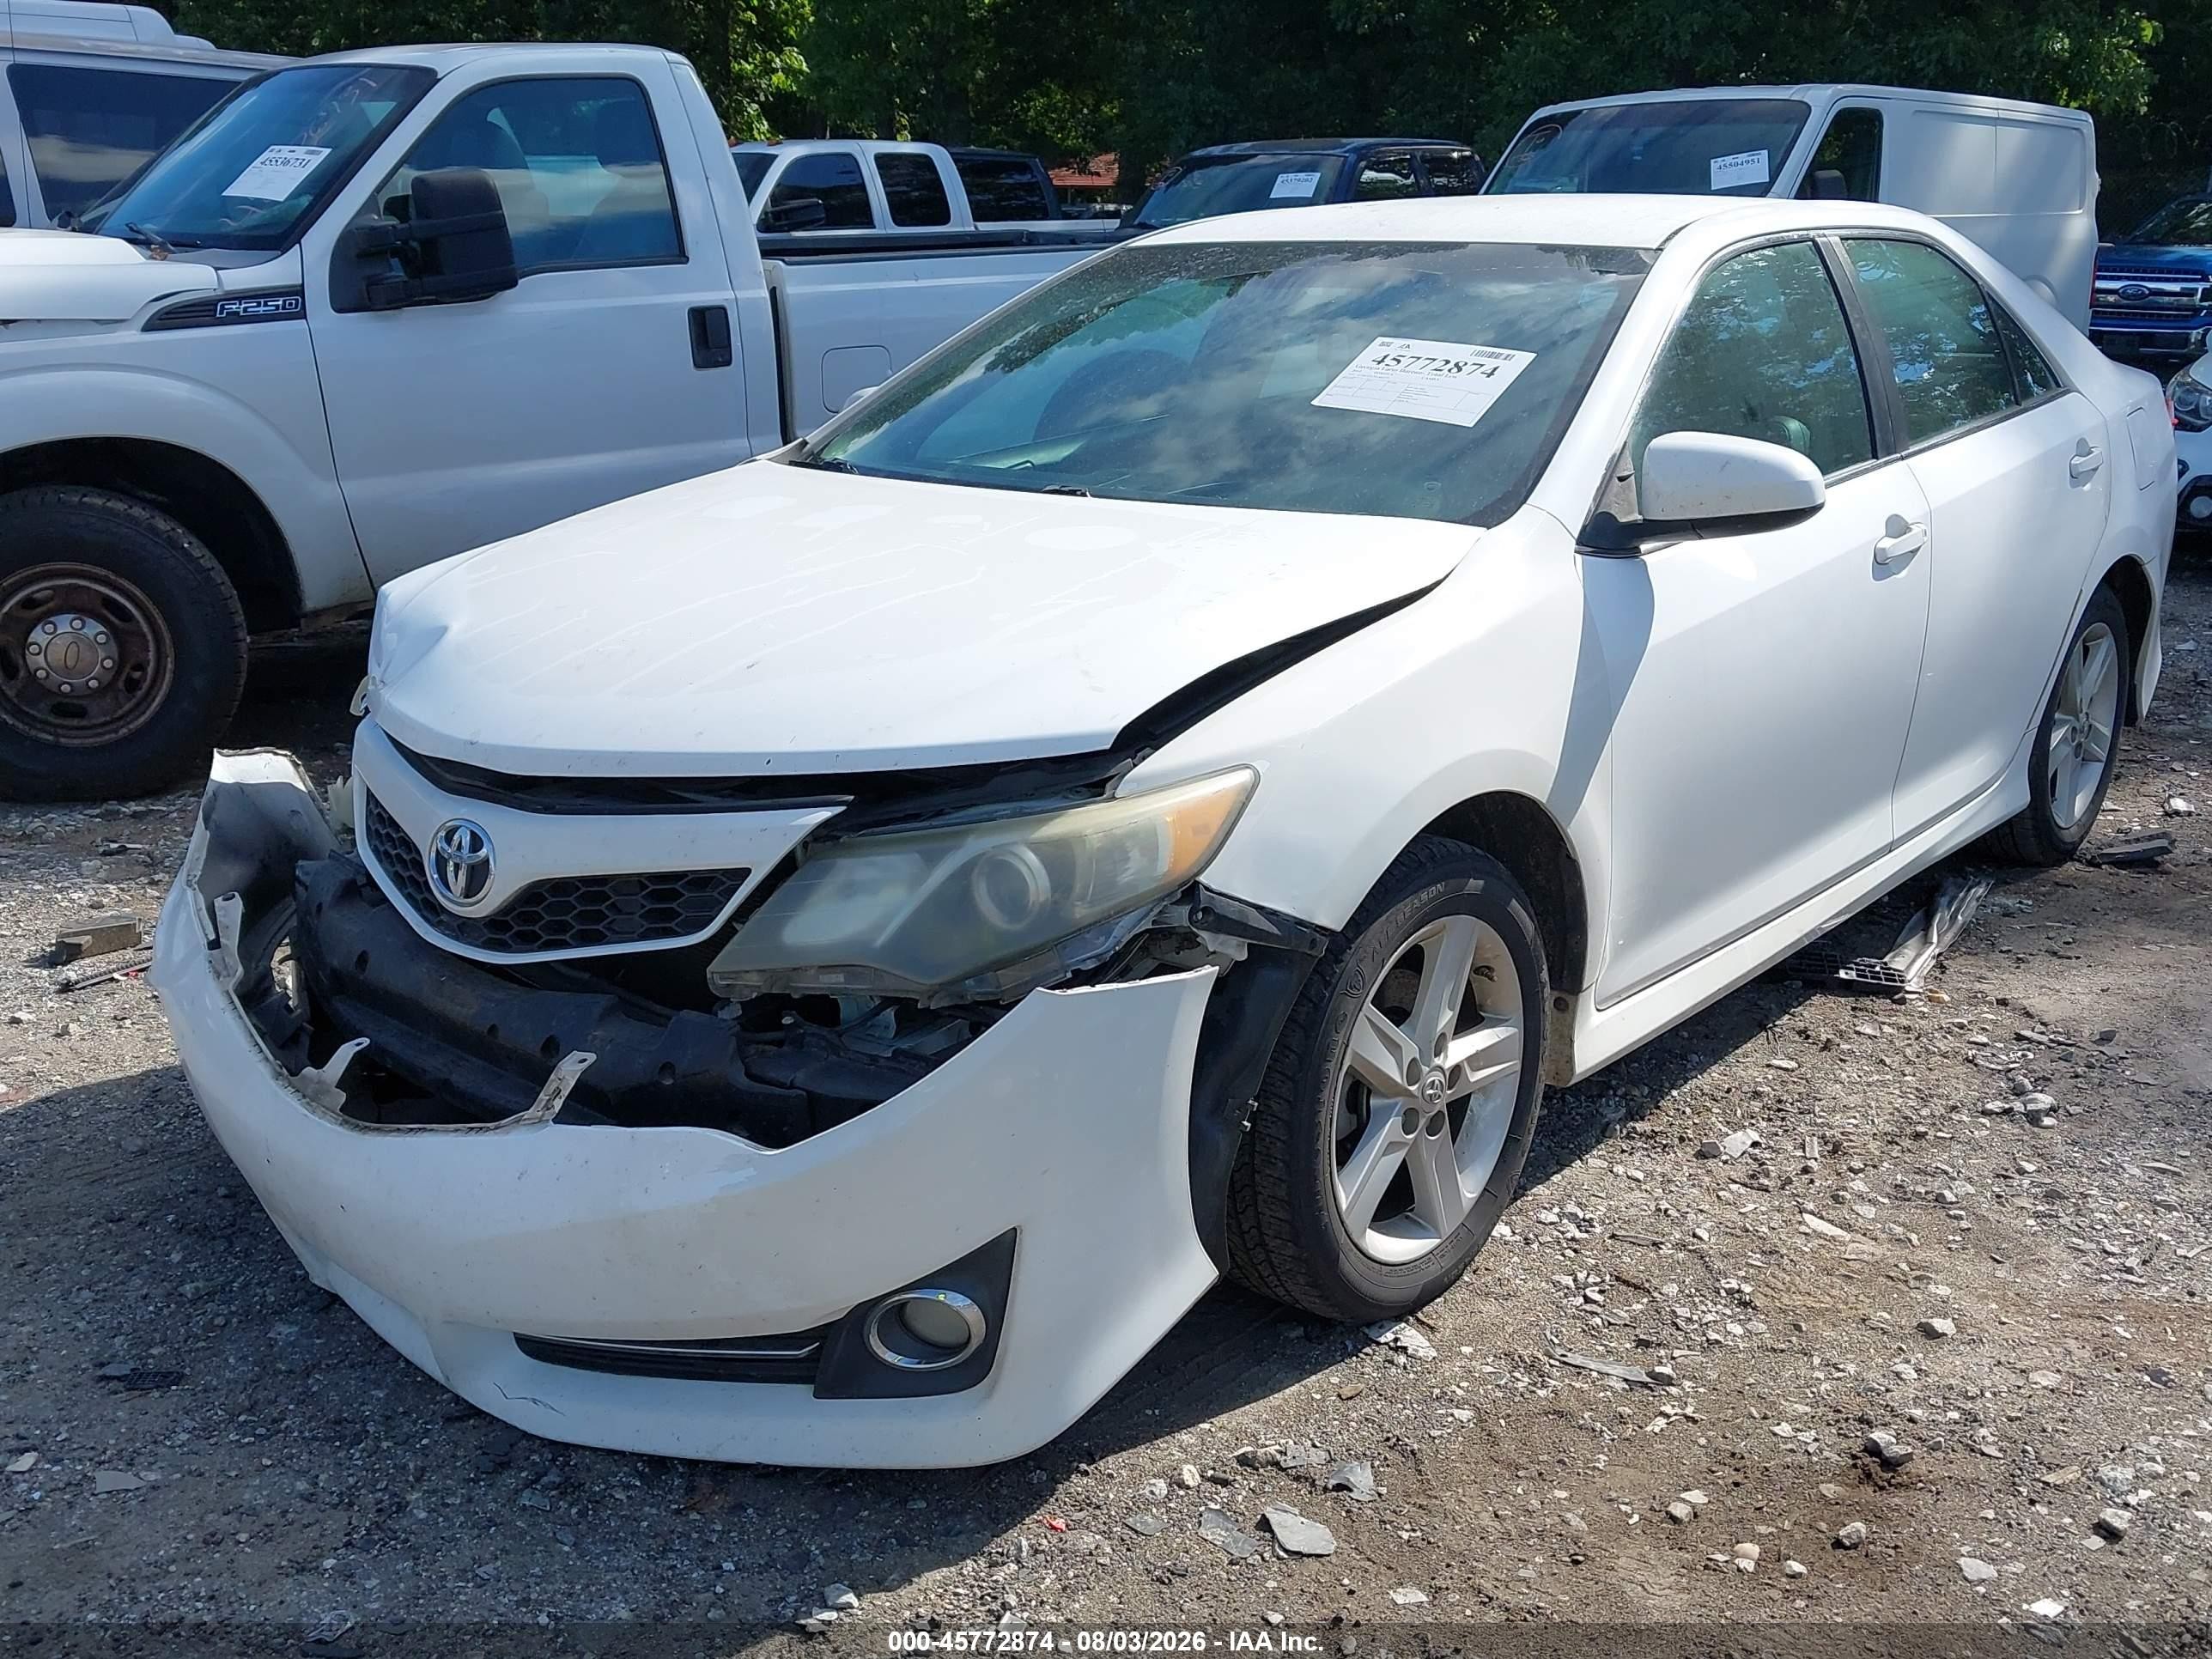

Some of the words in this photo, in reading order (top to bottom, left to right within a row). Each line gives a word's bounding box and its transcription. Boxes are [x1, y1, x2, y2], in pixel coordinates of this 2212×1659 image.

[259, 156, 311, 168] 45536731
[1717, 158, 1760, 170] 45504951
[1371, 353, 1502, 379] 45772874
